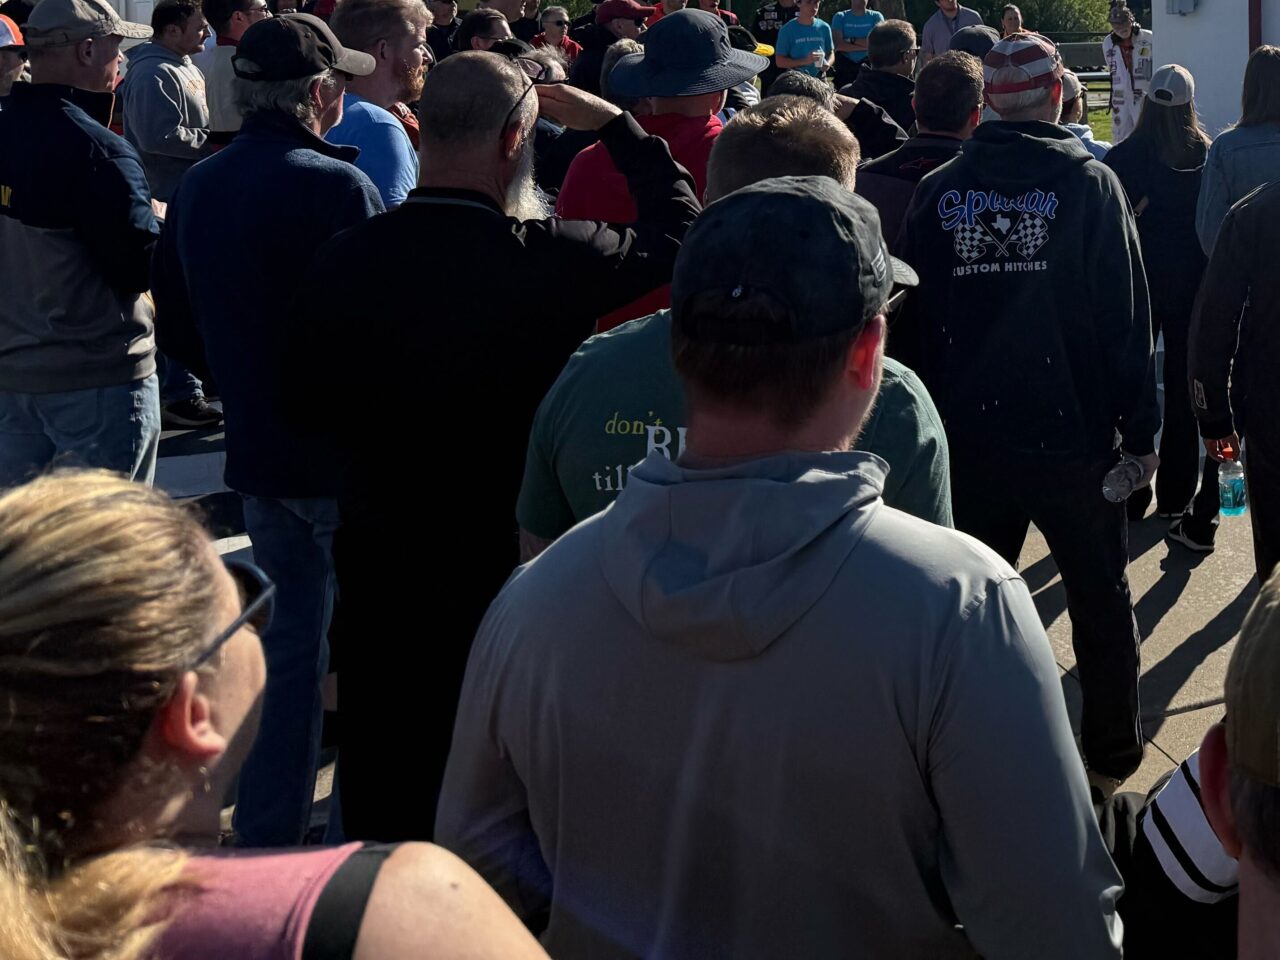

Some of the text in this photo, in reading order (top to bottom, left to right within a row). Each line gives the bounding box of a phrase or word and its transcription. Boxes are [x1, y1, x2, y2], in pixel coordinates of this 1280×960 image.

[1004, 260, 1048, 273] HITCHES
[604, 410, 663, 436] don't
[592, 463, 633, 491] til
